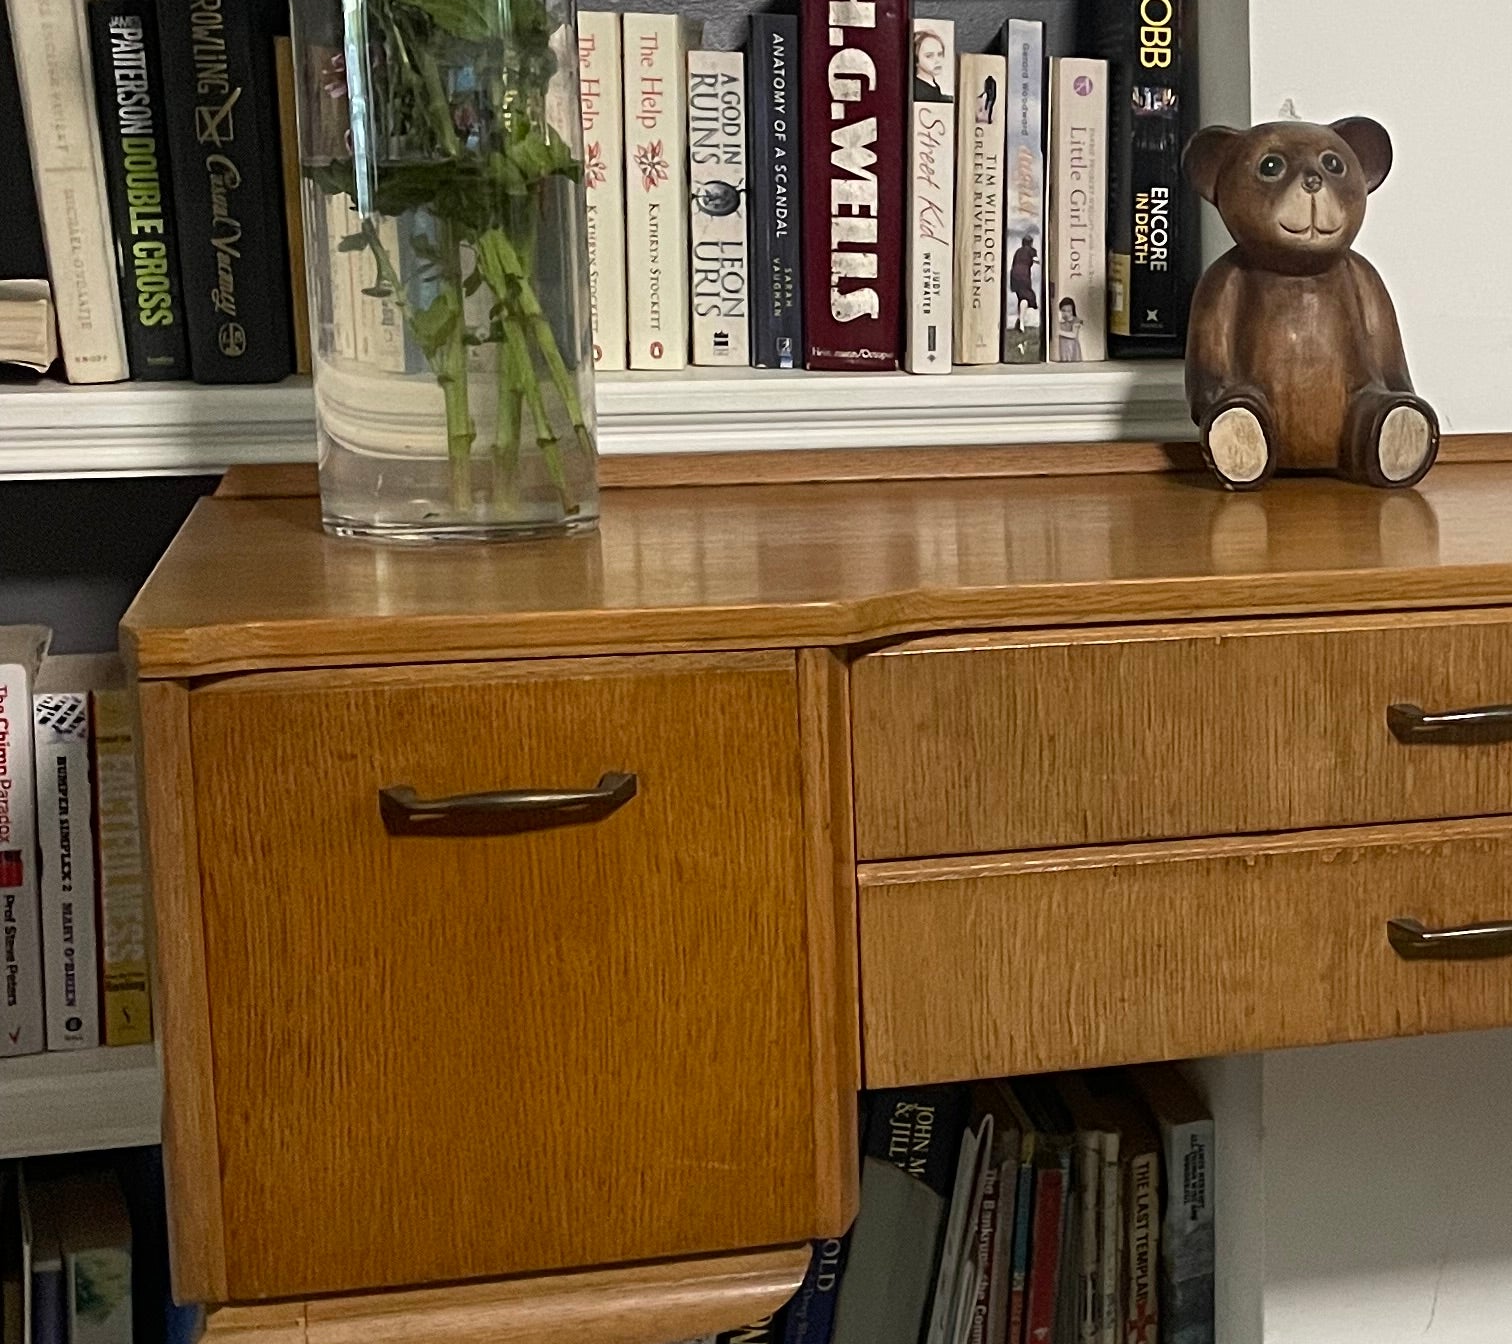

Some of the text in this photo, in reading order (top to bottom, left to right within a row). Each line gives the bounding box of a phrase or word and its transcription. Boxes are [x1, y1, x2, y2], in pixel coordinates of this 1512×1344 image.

[635, 31, 665, 129] The Help
[690, 71, 722, 167] RUINS
[721, 90, 742, 136] GOD
[110, 25, 174, 328] PATTERSON DOUBLE CROSS
[772, 32, 788, 239] ANATOMY OF A SCANDAL
[917, 106, 950, 247] Street Kid
[970, 125, 984, 311] GREEN RIVER RISING
[982, 153, 997, 285] TIM WILLOCKS
[1070, 125, 1088, 282] Little Girl Lost
[1135, 192, 1150, 266] IN DEATH
[1149, 186, 1170, 272] ENCORE
[648, 202, 662, 332] KATHRYN STOCKETT
[694, 240, 722, 318] URIS
[717, 240, 746, 319] LEON
[771, 256, 783, 318] VAUGHAN
[888, 1101, 916, 1162] & JILL
[908, 1102, 936, 1154] JOHN
[1134, 1160, 1151, 1308] THE LAST TEMPLAR
